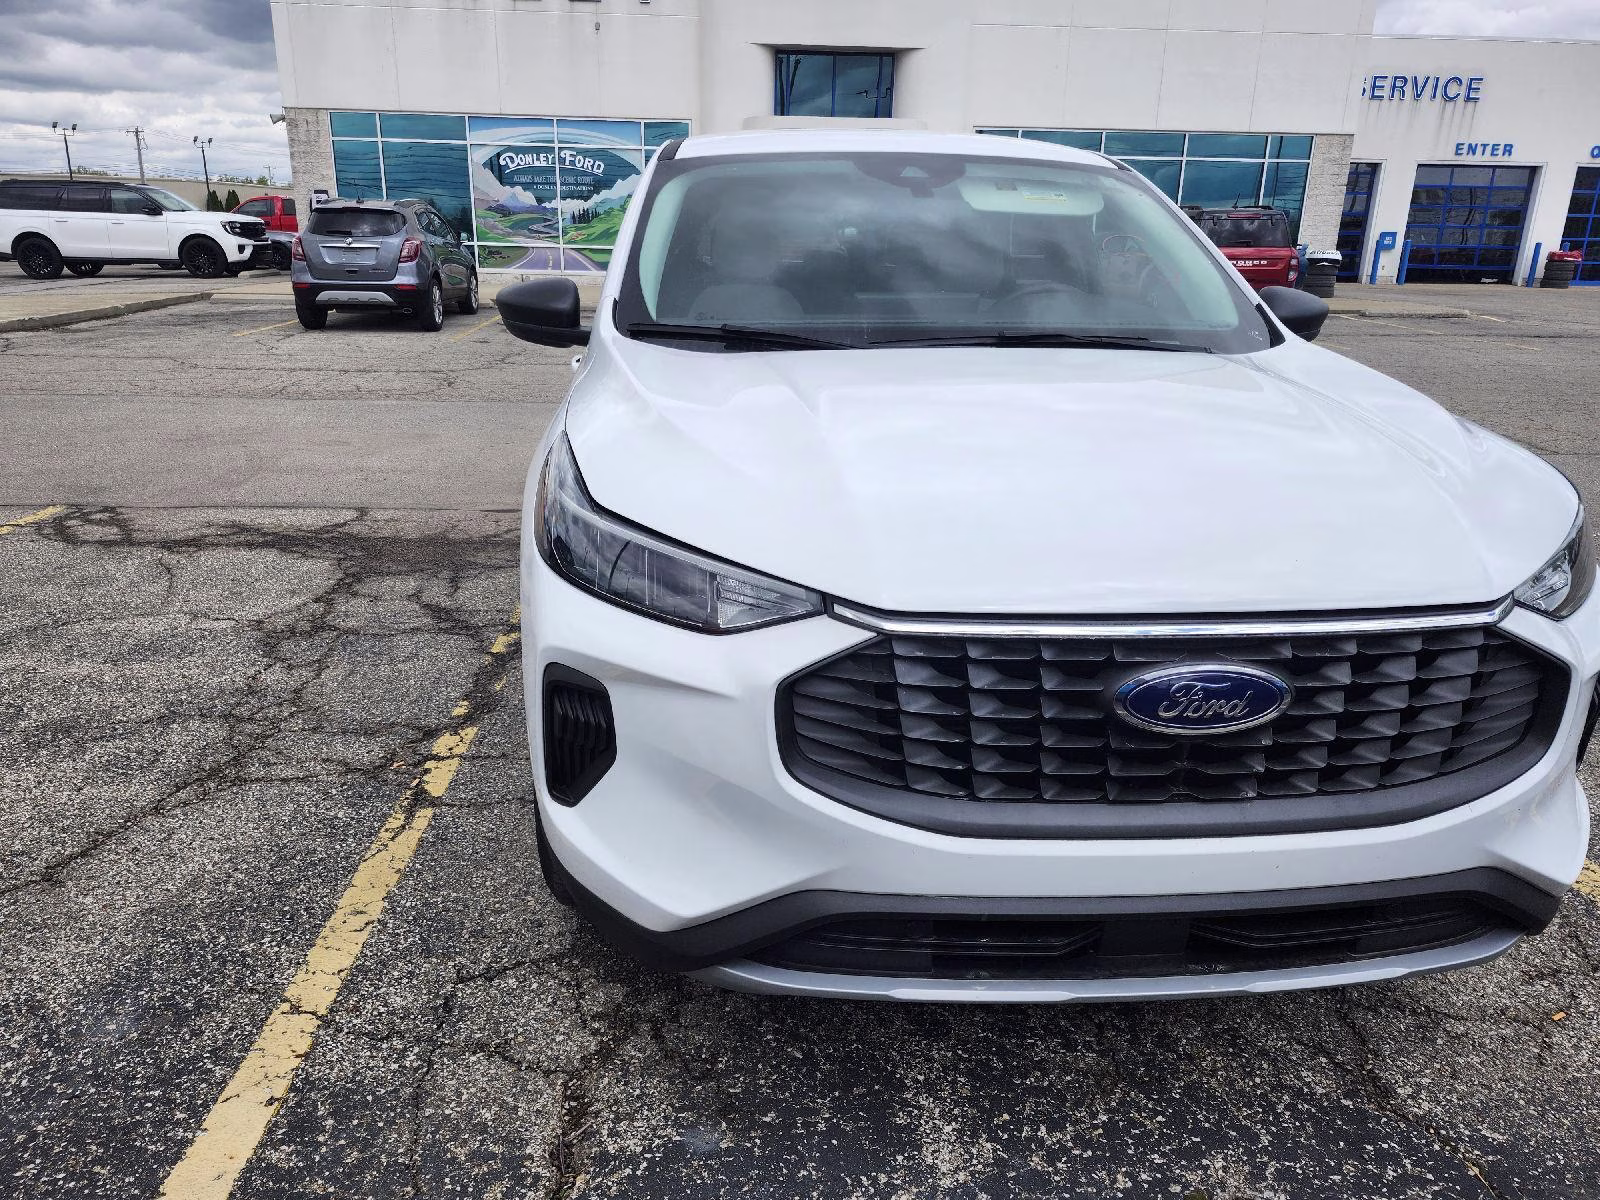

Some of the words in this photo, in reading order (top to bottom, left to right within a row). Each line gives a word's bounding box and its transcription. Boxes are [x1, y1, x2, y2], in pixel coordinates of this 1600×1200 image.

[1454, 142, 1513, 157] ENTER
[499, 152, 554, 168] DONLEY
[560, 150, 605, 174] FORD
[1158, 681, 1253, 717] Ford
